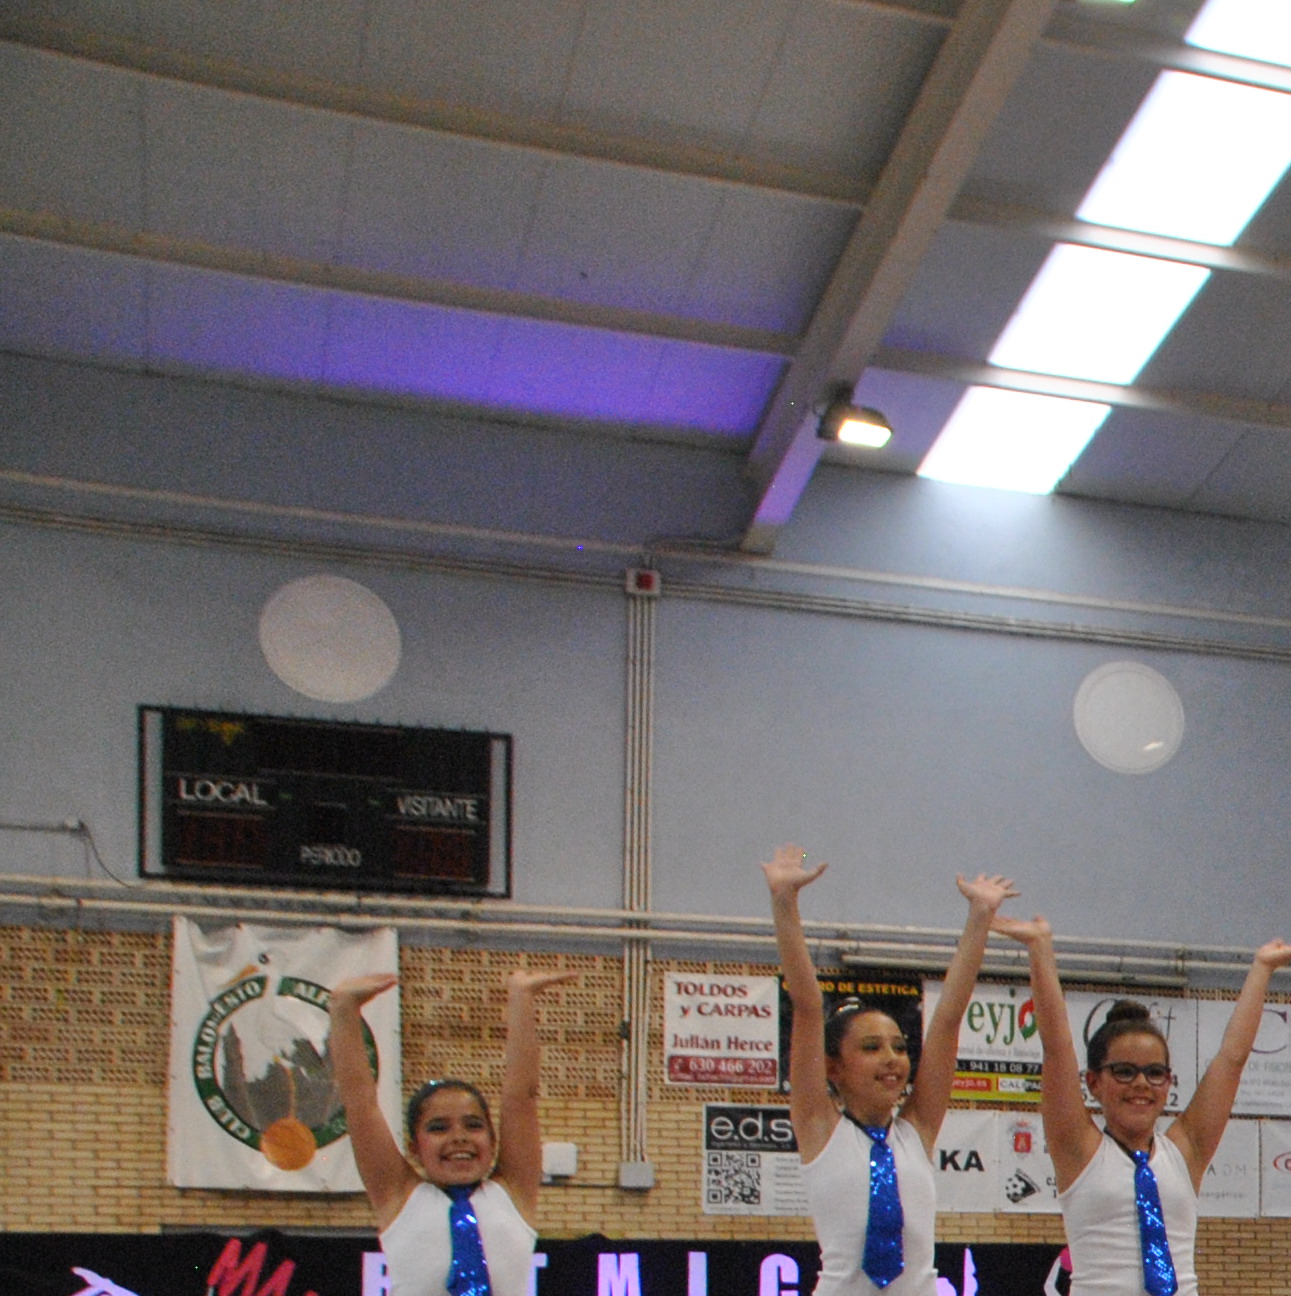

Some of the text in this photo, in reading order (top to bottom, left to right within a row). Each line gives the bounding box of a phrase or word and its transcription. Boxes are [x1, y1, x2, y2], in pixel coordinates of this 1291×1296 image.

[178, 779, 268, 806] LOCAL
[398, 796, 479, 821] VISITANTE
[293, 981, 332, 1008] ALF
[673, 981, 748, 998] TOLDOS
[782, 981, 835, 992] CRO
[838, 982, 855, 992] DE
[680, 1002, 771, 1018] y CARPAS
[967, 988, 1037, 1045] eyjo
[727, 1036, 773, 1052] Herce
[689, 1058, 772, 1075] 630 466 202
[970, 1061, 989, 1072] 941
[994, 1063, 1006, 1073] 18
[1027, 1065, 1039, 1075] 77
[939, 1149, 985, 1172] KA
